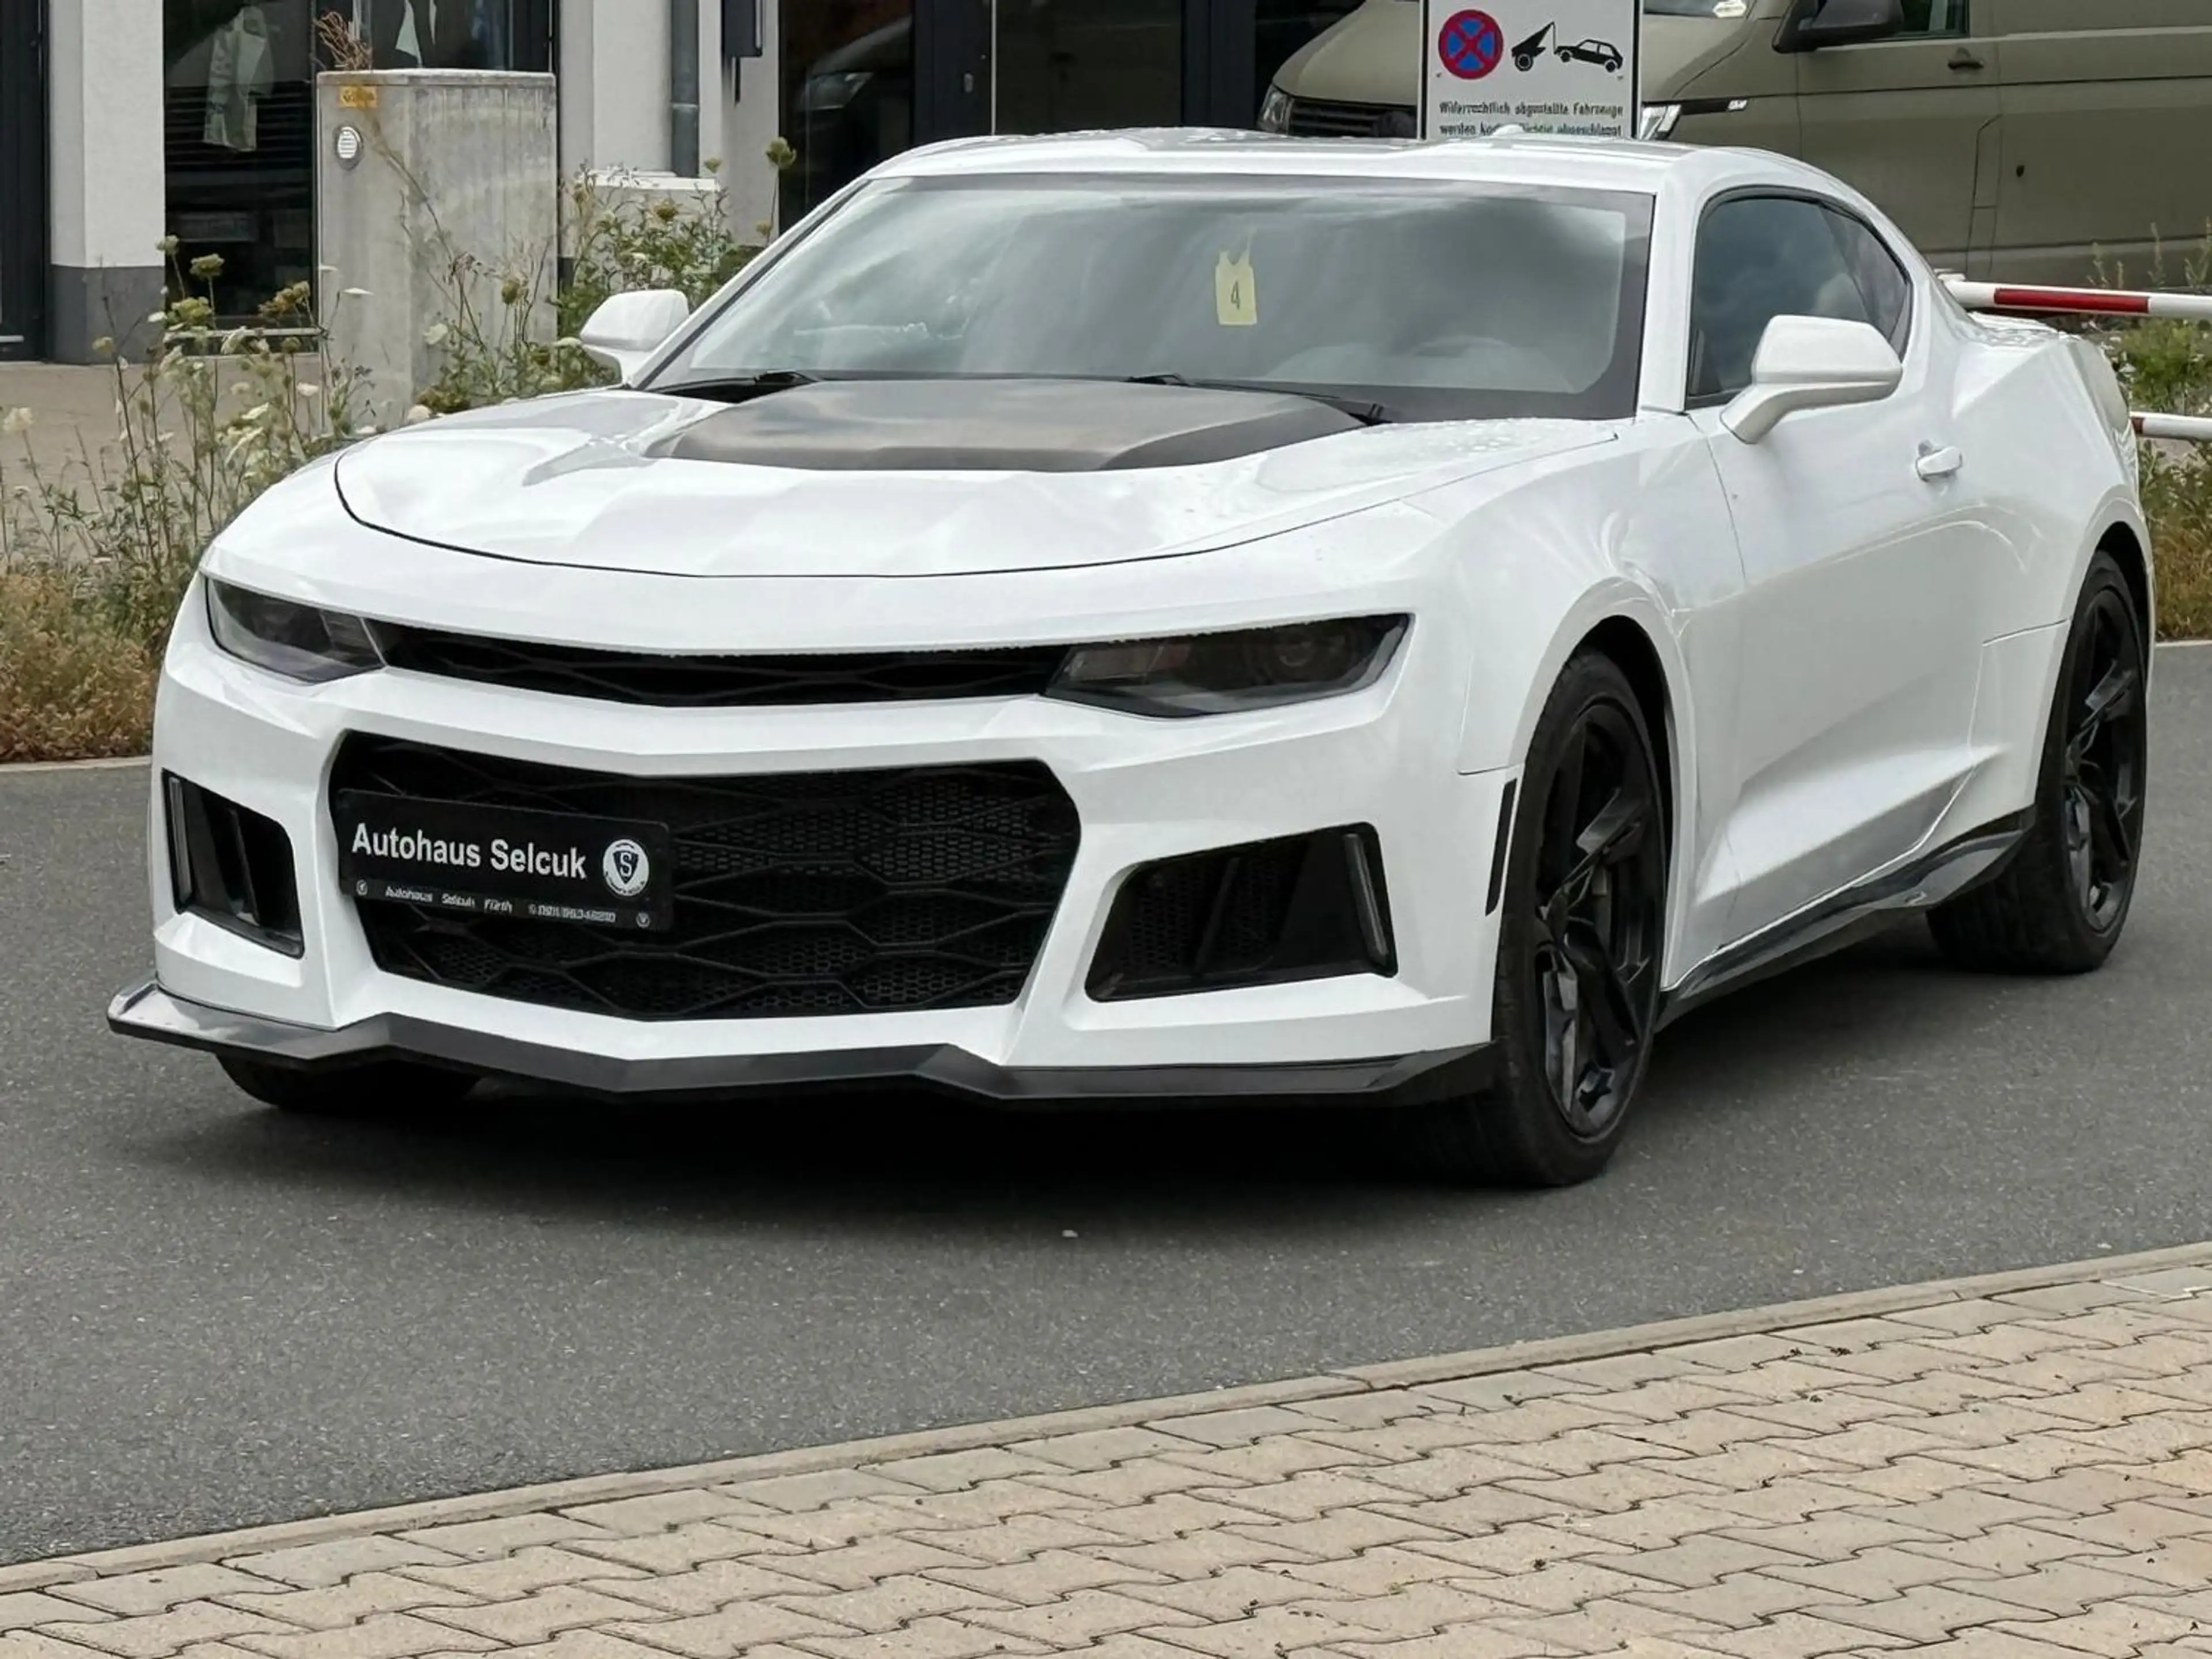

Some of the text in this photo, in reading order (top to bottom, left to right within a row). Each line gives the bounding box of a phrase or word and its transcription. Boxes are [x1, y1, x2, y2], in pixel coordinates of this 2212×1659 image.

[1515, 101, 1569, 118] abgestellte
[1573, 102, 1623, 119] Fahrzeuge
[1440, 122, 1475, 136] werden
[1231, 279, 1240, 309] 4
[352, 823, 587, 880] Autohaus Selcuk
[385, 885, 433, 903] Autohaus
